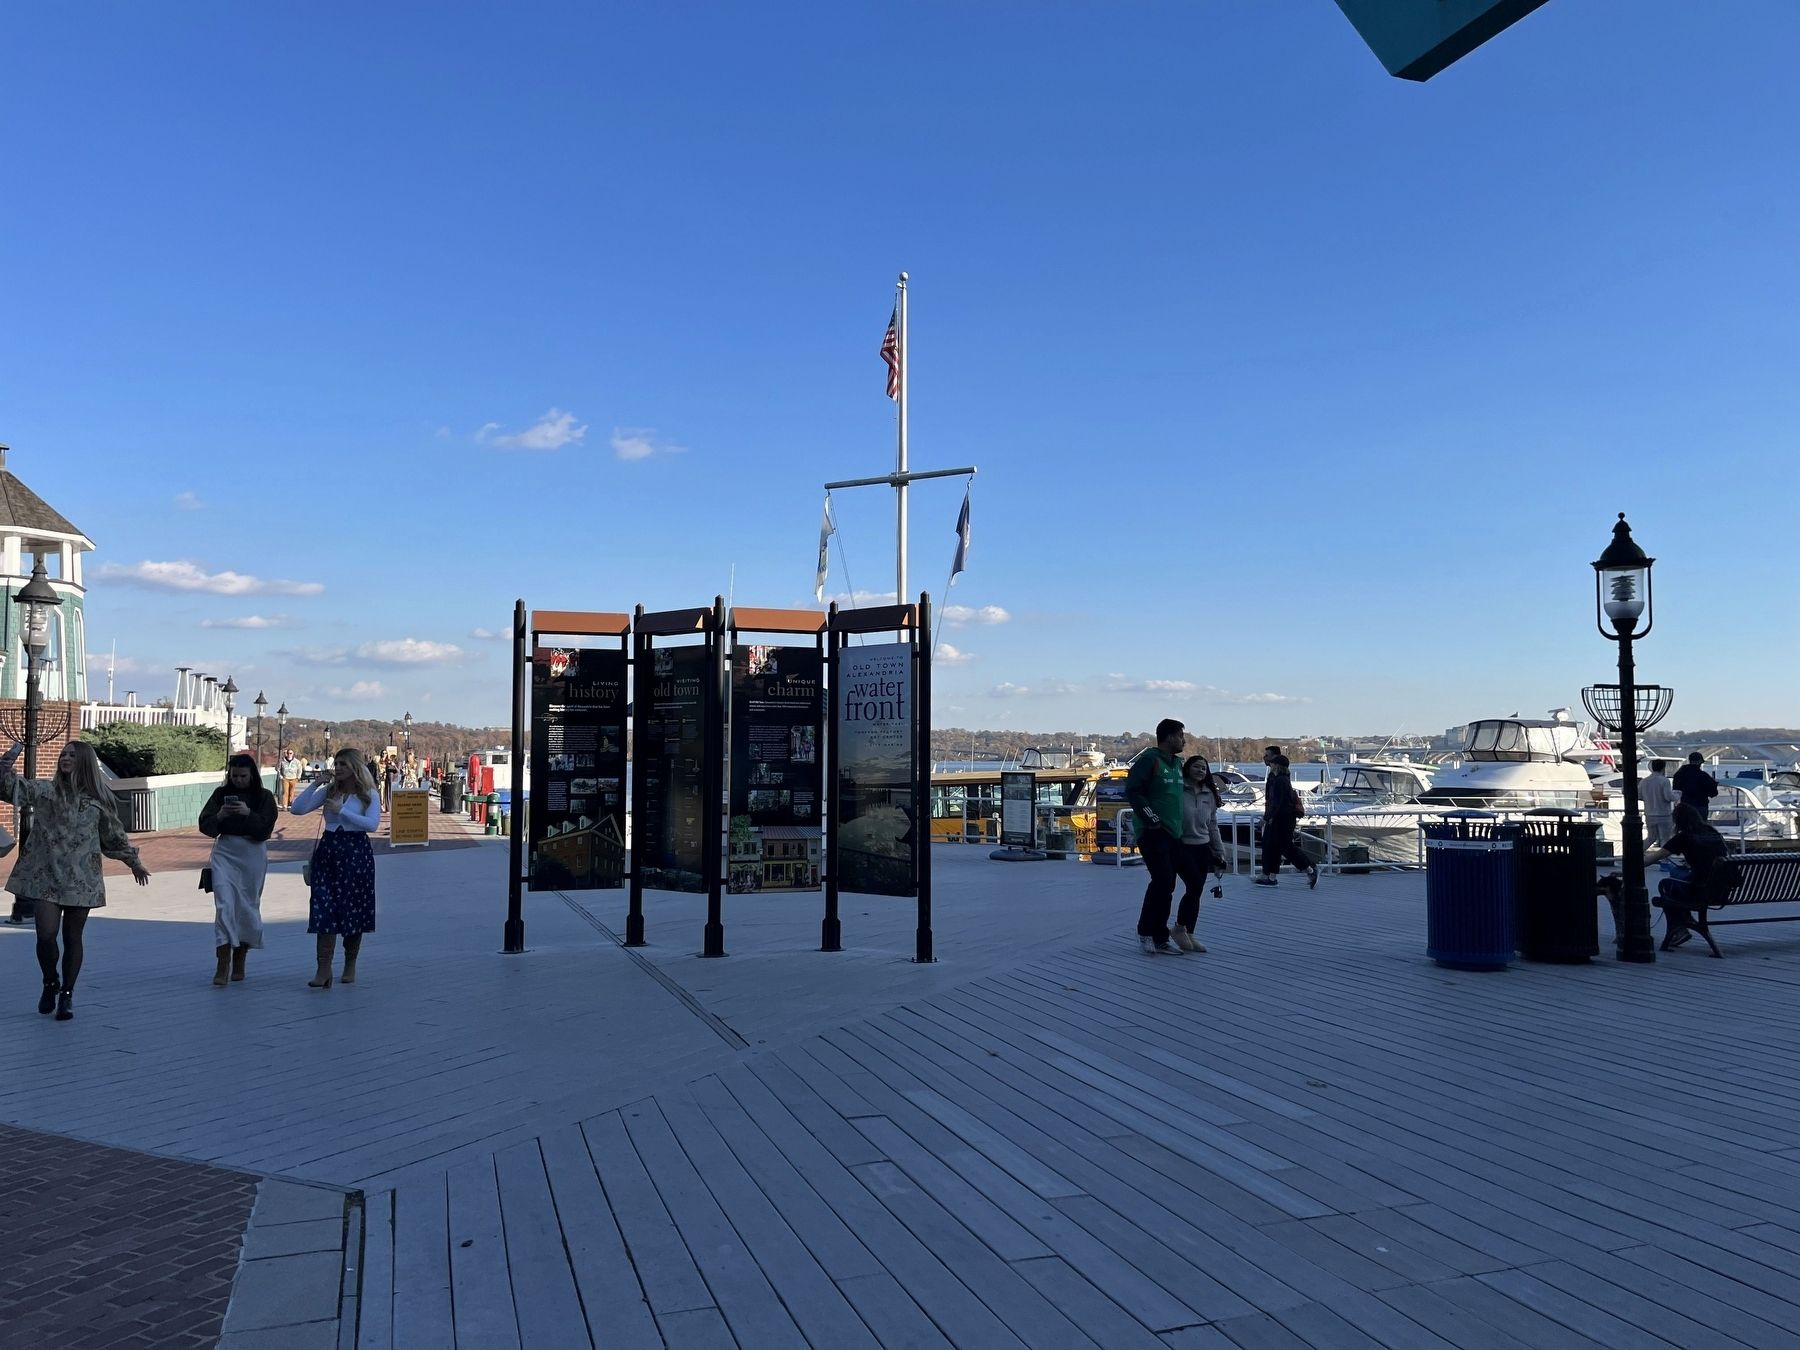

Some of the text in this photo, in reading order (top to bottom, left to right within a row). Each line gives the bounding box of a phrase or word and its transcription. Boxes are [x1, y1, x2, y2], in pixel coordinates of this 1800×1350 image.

[846, 670, 904, 678] ALEXANDRIA
[568, 682, 619, 703] history
[653, 681, 700, 697] old town
[767, 681, 815, 697] charm
[854, 677, 904, 698] water
[844, 690, 905, 721] front
